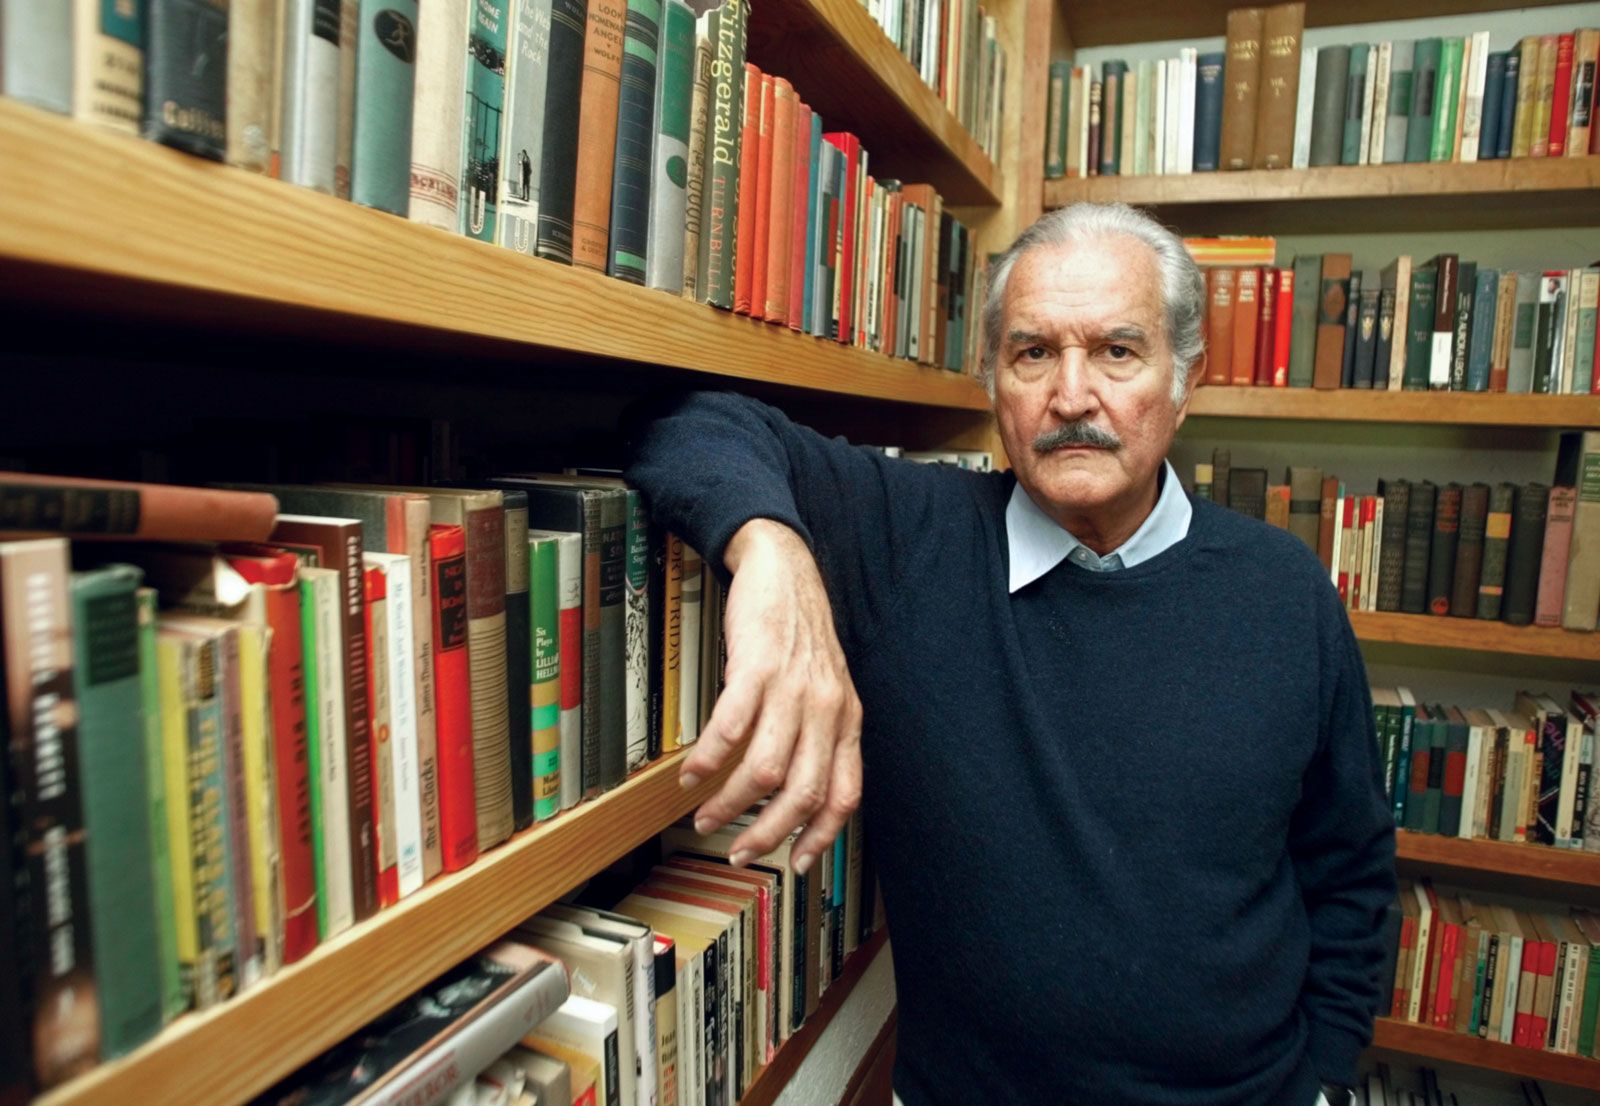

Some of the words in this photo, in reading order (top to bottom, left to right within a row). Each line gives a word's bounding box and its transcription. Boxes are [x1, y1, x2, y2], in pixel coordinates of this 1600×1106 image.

[521, 40, 543, 65] Rock
[593, 27, 622, 46] ANGEL
[711, 0, 740, 166] Fitzgerald
[708, 175, 727, 295] TURNBULL
[668, 595, 684, 672] FRIDAY
